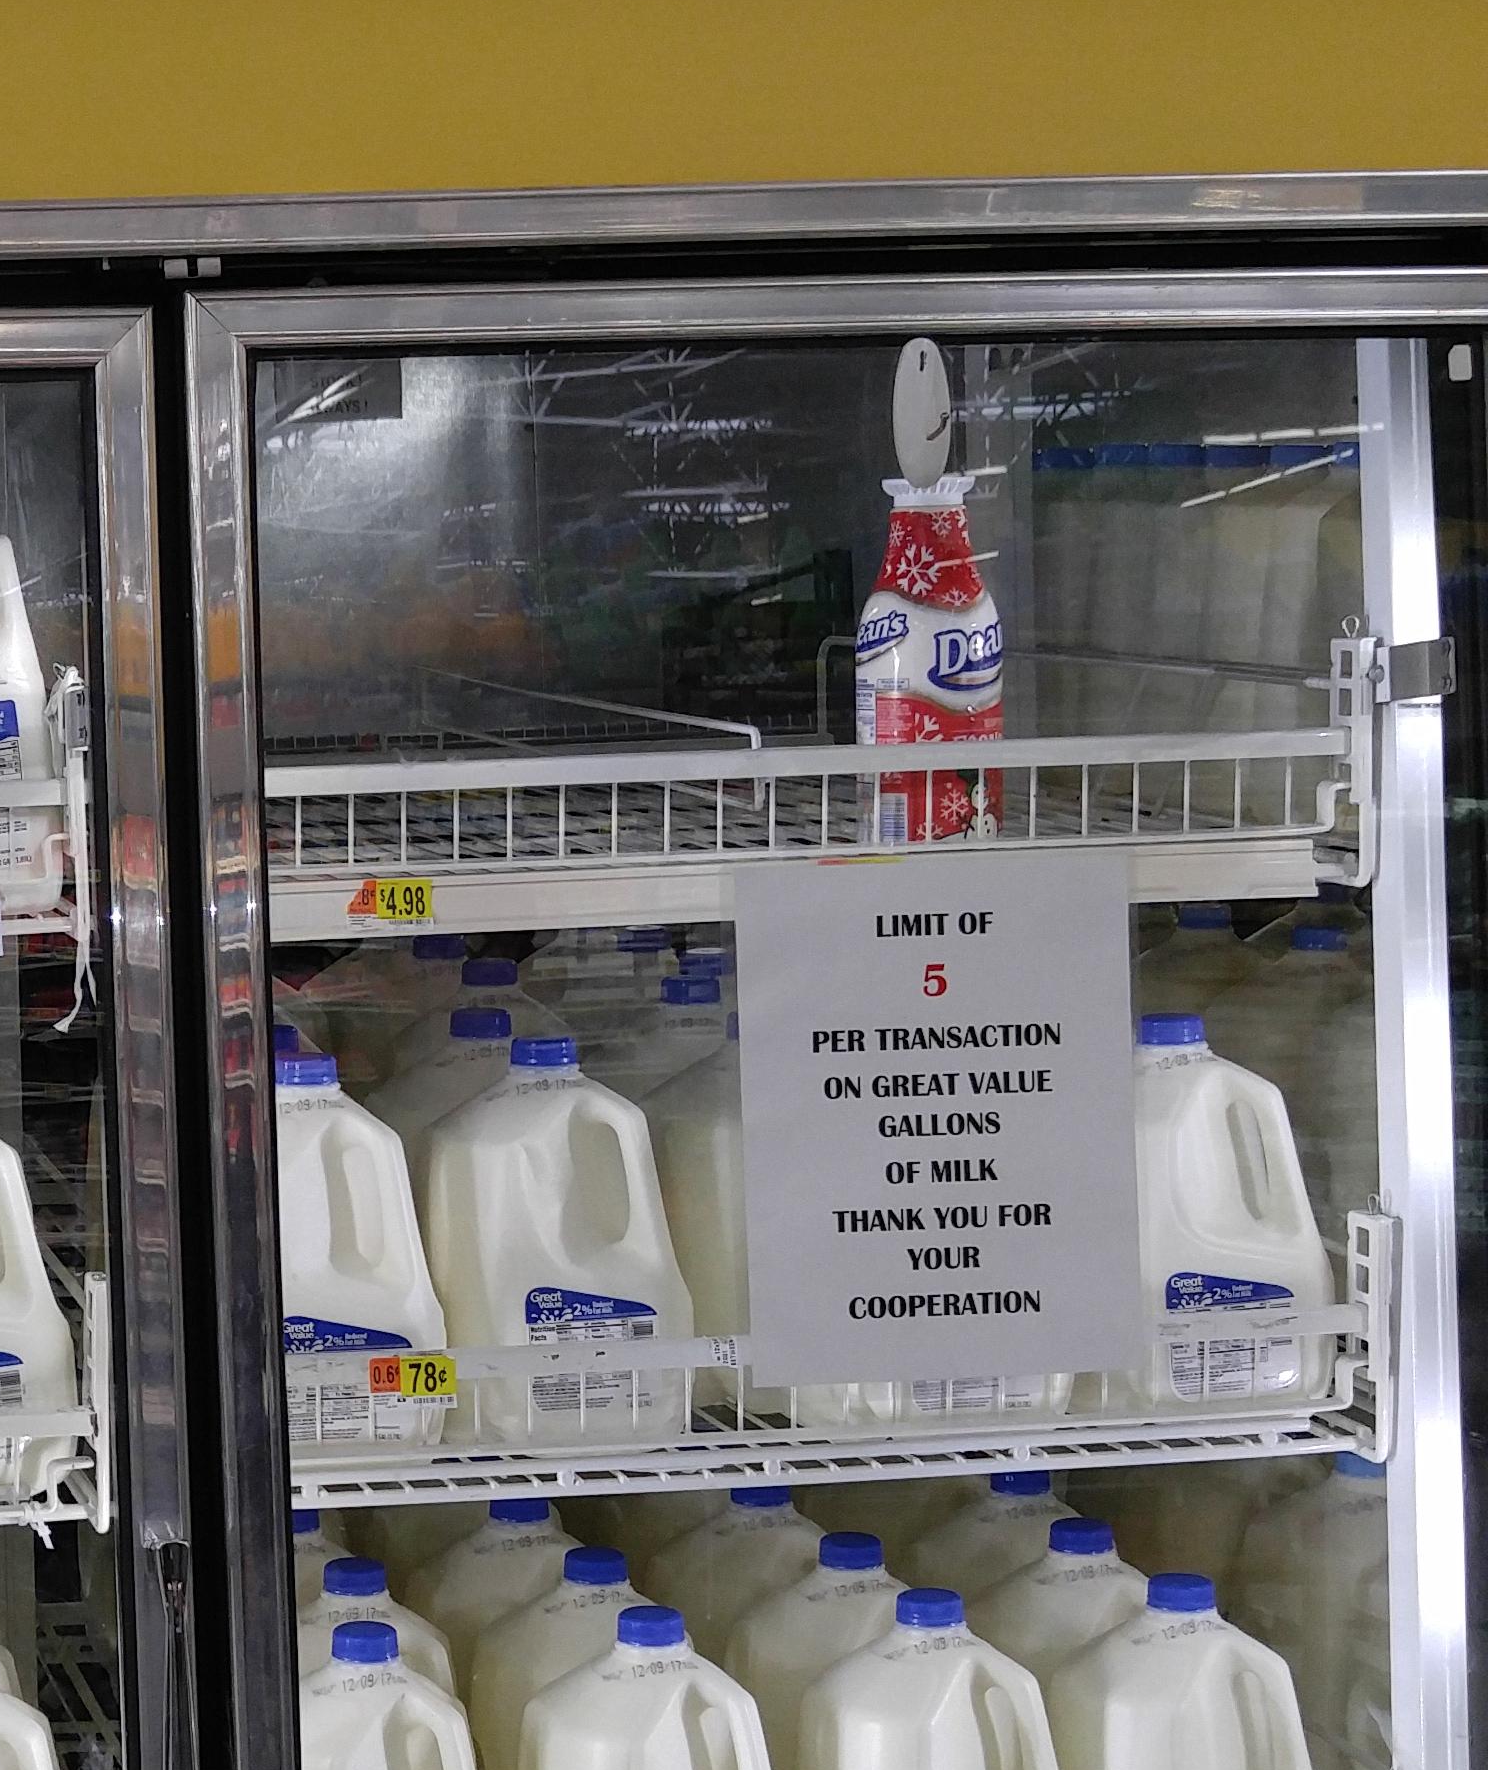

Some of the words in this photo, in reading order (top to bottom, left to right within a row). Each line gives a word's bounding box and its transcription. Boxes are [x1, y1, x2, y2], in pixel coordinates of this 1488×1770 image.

[857, 610, 909, 642] ean's
[379, 884, 426, 917] $4.98
[875, 913, 948, 938] LIMIT
[958, 911, 994, 934] OF
[923, 963, 947, 996] 5
[812, 1029, 865, 1053] PER
[875, 1022, 1062, 1051] TRANSACTION
[824, 1076, 862, 1099] ON
[872, 1072, 959, 1097] GREAT
[967, 1069, 1053, 1095] VALUE
[878, 1112, 1001, 1138] GALLONS
[885, 1161, 921, 1184] OF
[930, 1158, 998, 1183] MILK
[832, 1207, 925, 1233] THANK
[934, 1205, 989, 1230] YOU
[998, 1202, 1052, 1227] FOR
[907, 1245, 981, 1270] YOUR
[1171, 1278, 1204, 1288] Great
[1180, 1286, 1204, 1294] Value
[1213, 1289, 1232, 1300] 2%
[531, 1293, 563, 1303] Great
[538, 1300, 563, 1309] Value
[573, 1304, 593, 1316] 2%
[848, 1290, 1041, 1319] COOPERATION
[283, 1323, 315, 1334] Great
[288, 1331, 314, 1340] Value
[324, 1336, 344, 1347] 2%
[408, 1359, 448, 1393] 78¢
